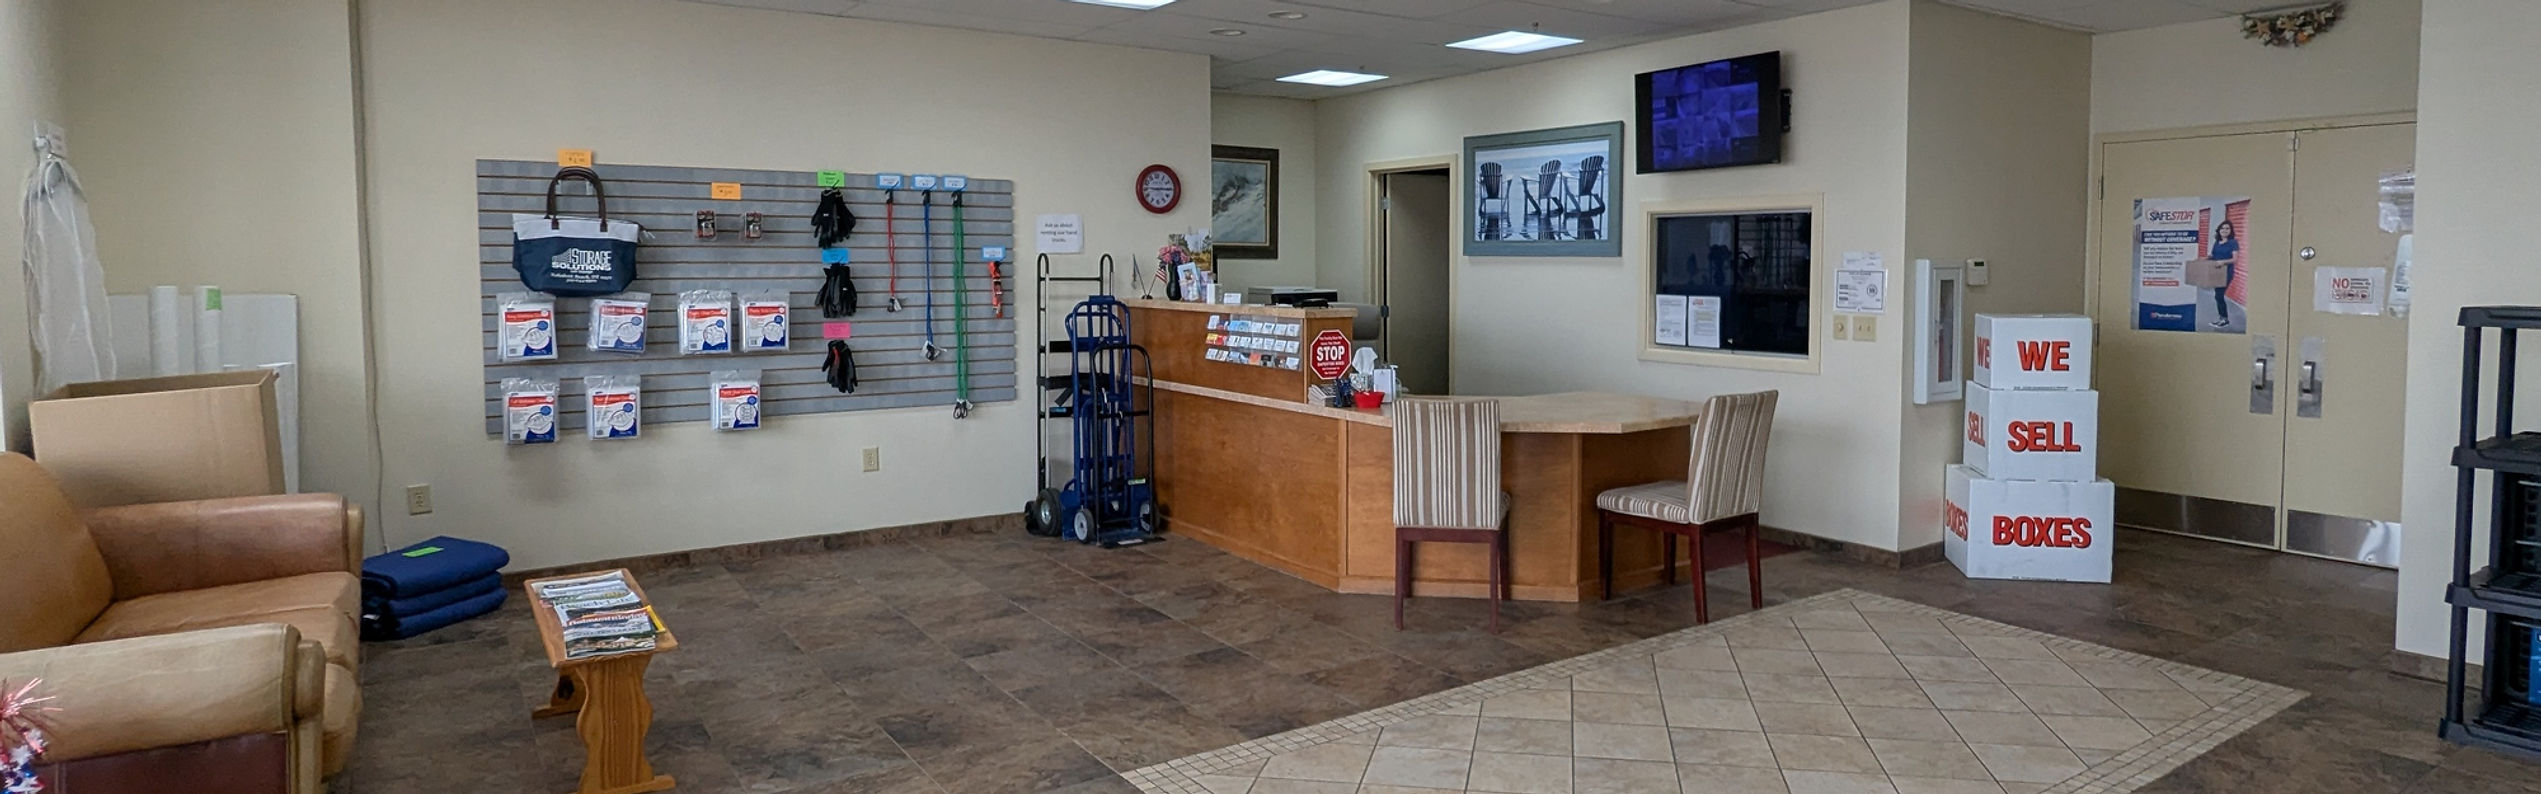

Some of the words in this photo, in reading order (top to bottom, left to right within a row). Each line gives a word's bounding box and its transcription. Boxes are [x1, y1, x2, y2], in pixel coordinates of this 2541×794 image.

[2149, 210, 2195, 221] SAFESTOR
[552, 261, 612, 271] SOLUTIONS
[571, 248, 612, 265] STORAGE
[2332, 278, 2350, 289] NO
[1316, 345, 1345, 361] STOP
[1976, 336, 1991, 369] WE
[2017, 340, 2071, 371] WE
[1967, 411, 1985, 447] SELL
[2008, 421, 2081, 452] SELL
[1945, 499, 1968, 541] BOXES
[1992, 515, 2093, 549] BOXES
